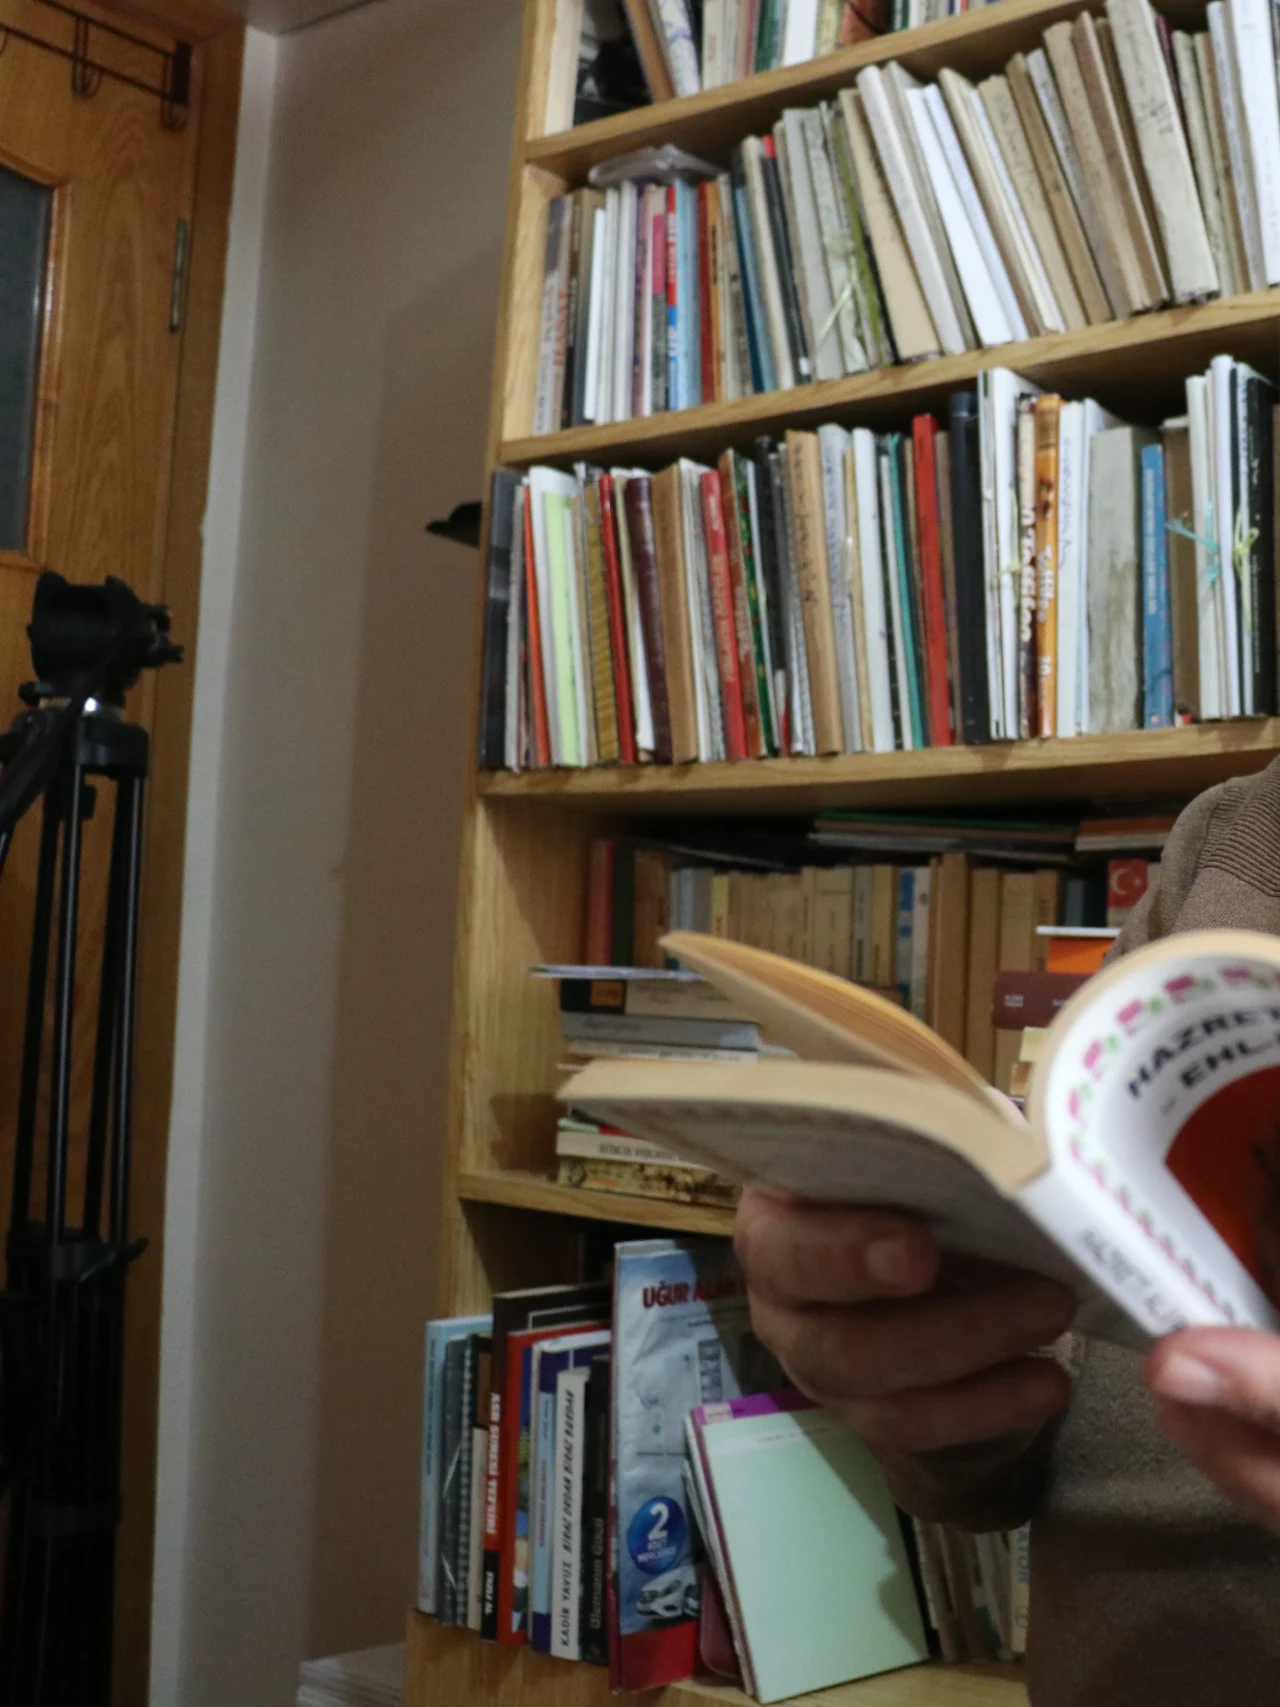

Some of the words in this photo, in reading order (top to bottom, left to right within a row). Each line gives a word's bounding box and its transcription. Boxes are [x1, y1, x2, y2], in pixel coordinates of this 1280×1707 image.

[642, 1280, 690, 1310] UĞUR
[647, 1502, 670, 1541] 2
[561, 1562, 572, 1604] YAVUZ
[560, 1607, 570, 1647] KADİR
